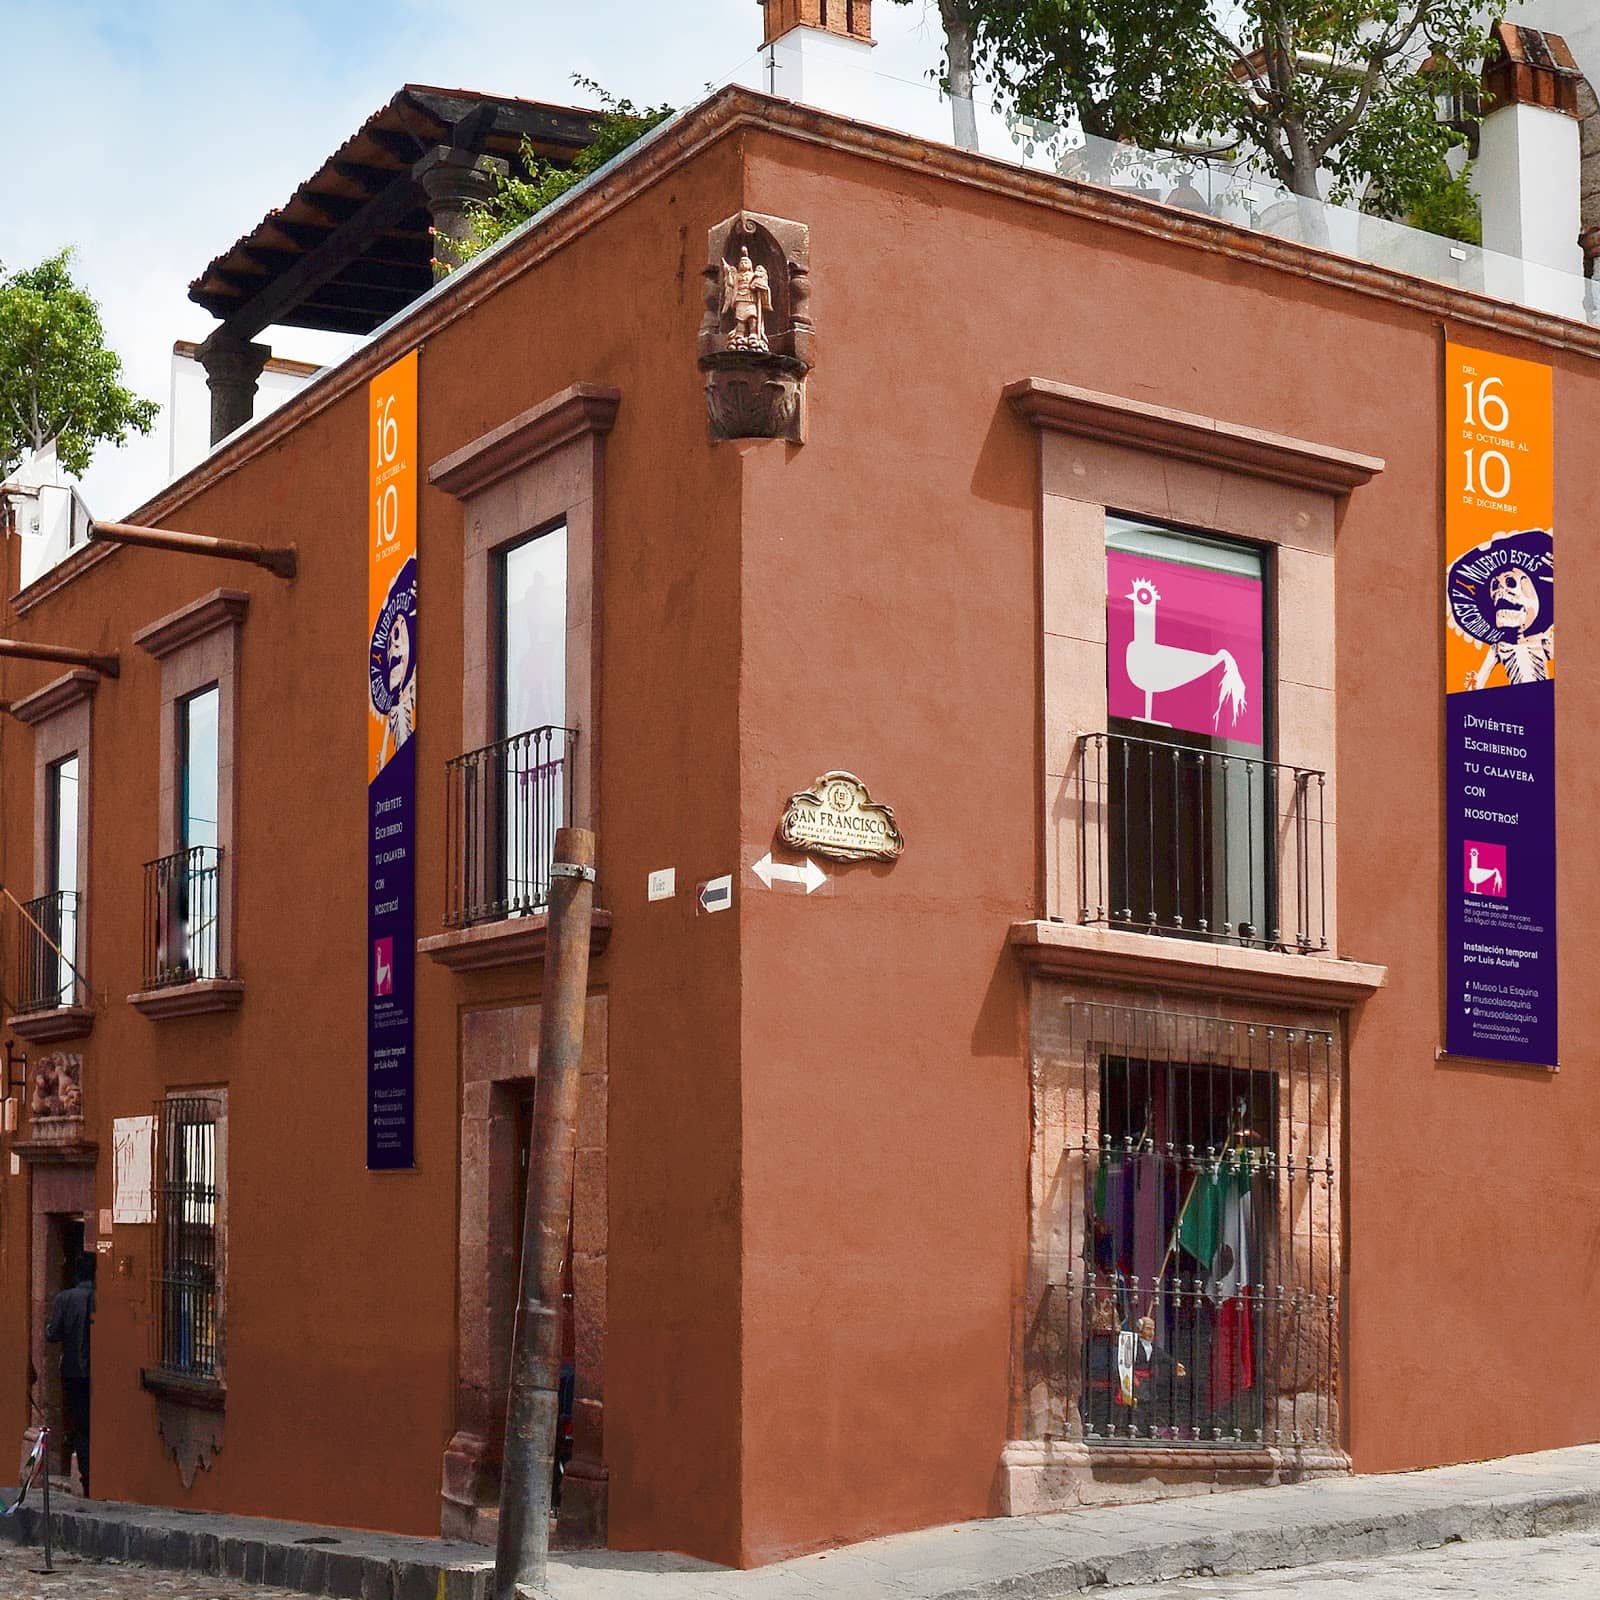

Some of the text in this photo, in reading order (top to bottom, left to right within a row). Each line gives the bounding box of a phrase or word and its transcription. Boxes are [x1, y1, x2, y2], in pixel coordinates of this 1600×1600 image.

[1462, 365, 1477, 376] DEL
[1463, 377, 1509, 432] 16
[376, 394, 398, 468] 16
[1462, 430, 1529, 452] DE OCTUBRE AL
[1463, 448, 1511, 499] 10
[1463, 496, 1518, 514] DE DICIEMBRE
[376, 484, 398, 548] 10
[1456, 549, 1543, 585] MUERTO ESTÁS
[373, 599, 396, 649] MUERTO
[1464, 762, 1535, 782] TU CALAVERA
[1464, 785, 1486, 797] CON
[791, 808, 816, 823] SAN
[820, 812, 887, 835] FRANCISCO
[1464, 807, 1519, 825] NOSOTROS!
[1463, 942, 1538, 960] Instalación temporal
[1463, 954, 1520, 968] por Luis Acuña
[1472, 981, 1539, 998] Museo La Esquina
